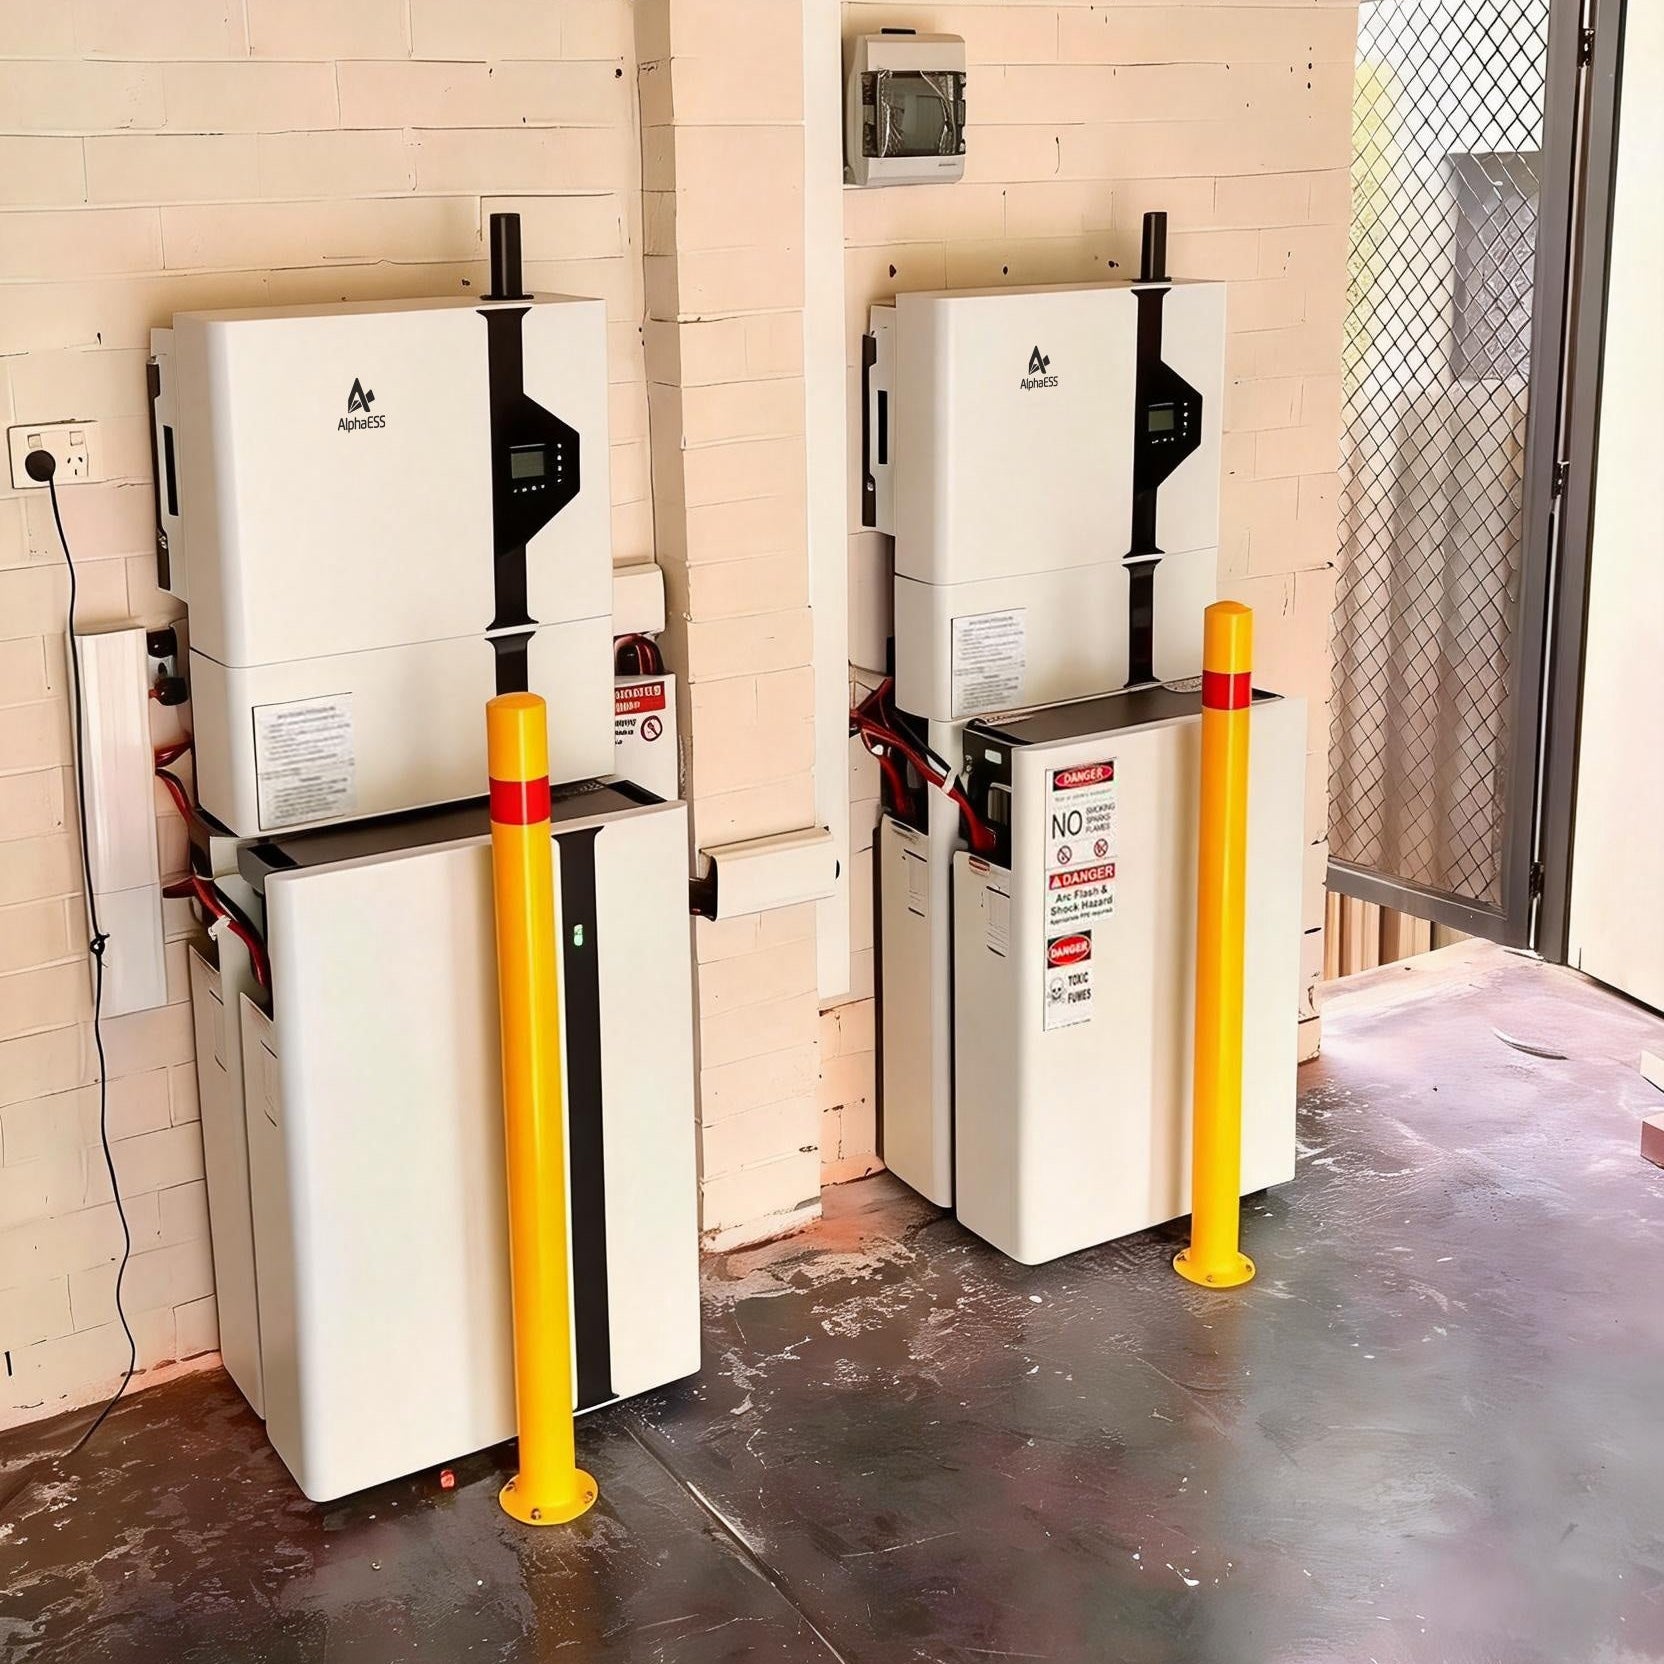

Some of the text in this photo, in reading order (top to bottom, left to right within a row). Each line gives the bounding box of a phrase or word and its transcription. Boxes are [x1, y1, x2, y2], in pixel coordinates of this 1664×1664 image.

[1020, 376, 1058, 391] AlphaESS
[338, 415, 386, 433] AlphaESS
[1063, 767, 1104, 784] DANGER
[1052, 810, 1082, 839] NO
[1062, 865, 1114, 885] DANGER
[1055, 884, 1107, 904] Arc Flash &
[1050, 895, 1113, 916] Shock Hazard
[1050, 940, 1088, 959] DANGER
[1068, 971, 1089, 986] TOXIC
[1068, 988, 1091, 1004] FUMES
